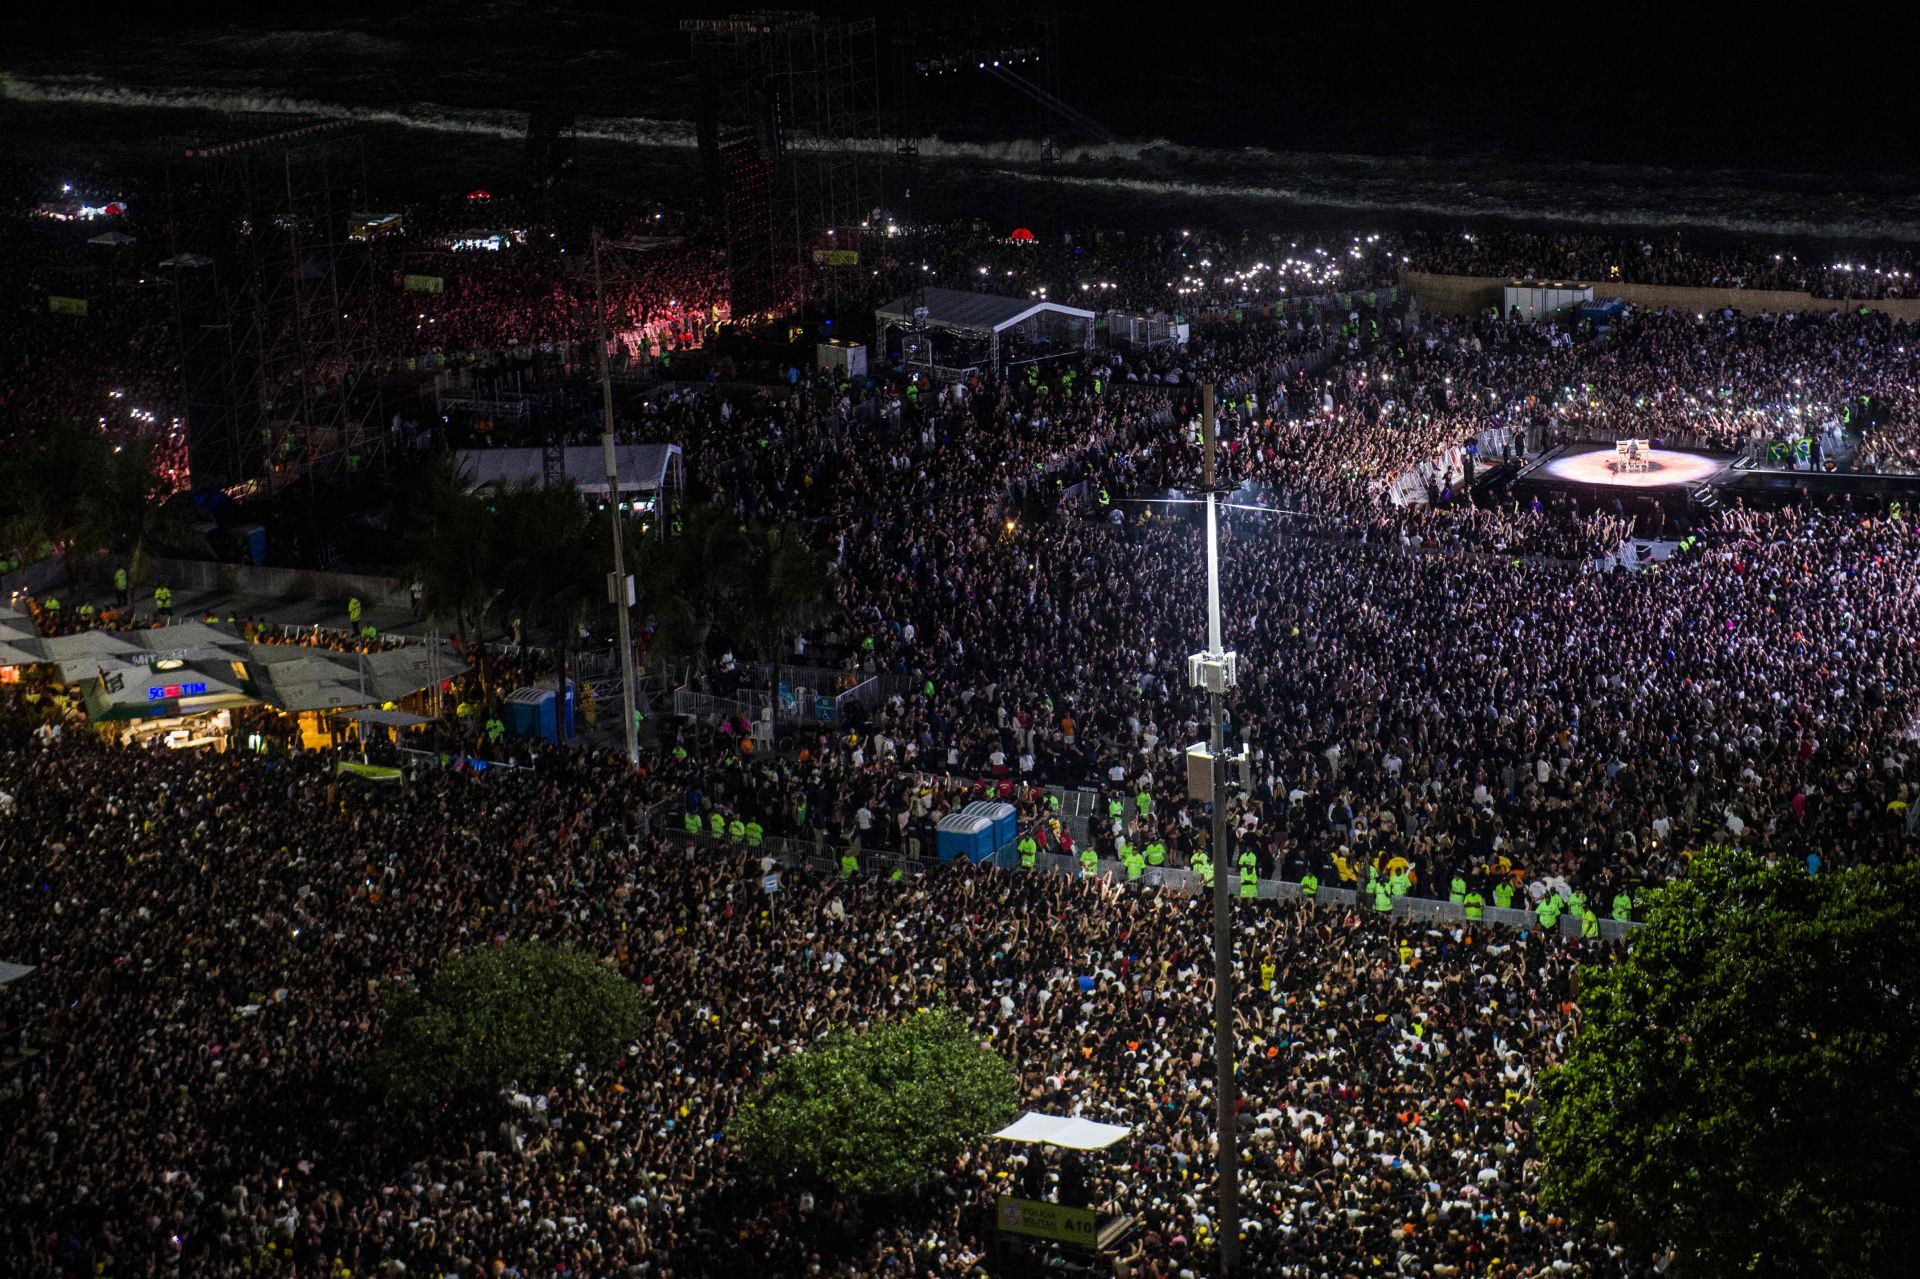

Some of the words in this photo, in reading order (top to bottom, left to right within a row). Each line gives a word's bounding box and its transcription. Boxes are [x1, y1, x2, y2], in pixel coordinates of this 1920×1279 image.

[147, 686, 165, 701] 5G
[181, 681, 206, 696] TIM
[1064, 1218, 1092, 1233] A10
